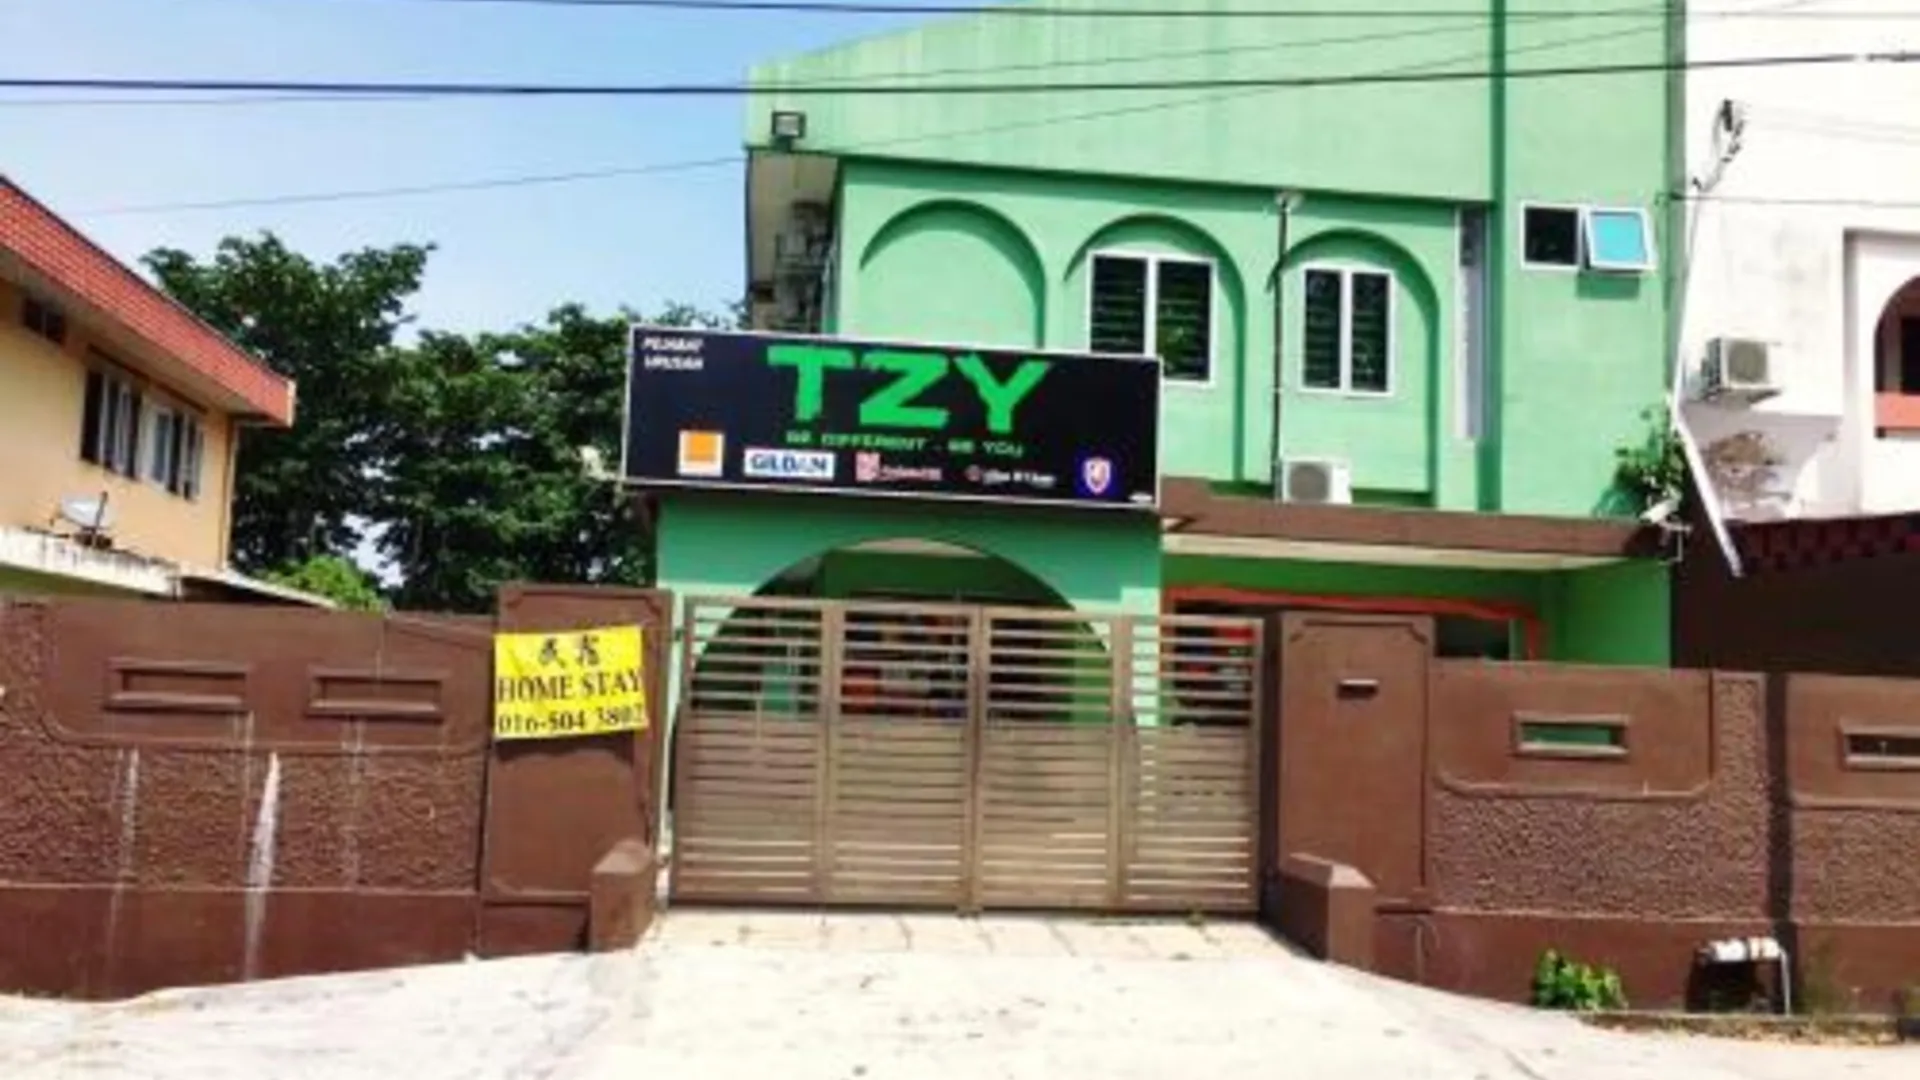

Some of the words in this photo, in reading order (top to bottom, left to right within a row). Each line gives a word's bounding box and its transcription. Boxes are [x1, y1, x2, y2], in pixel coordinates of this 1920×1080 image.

[767, 345, 1051, 434] TZY
[751, 453, 828, 472] GILDAN
[983, 441, 1023, 458] YOU
[499, 675, 573, 702] HOME
[581, 668, 642, 697] STAY
